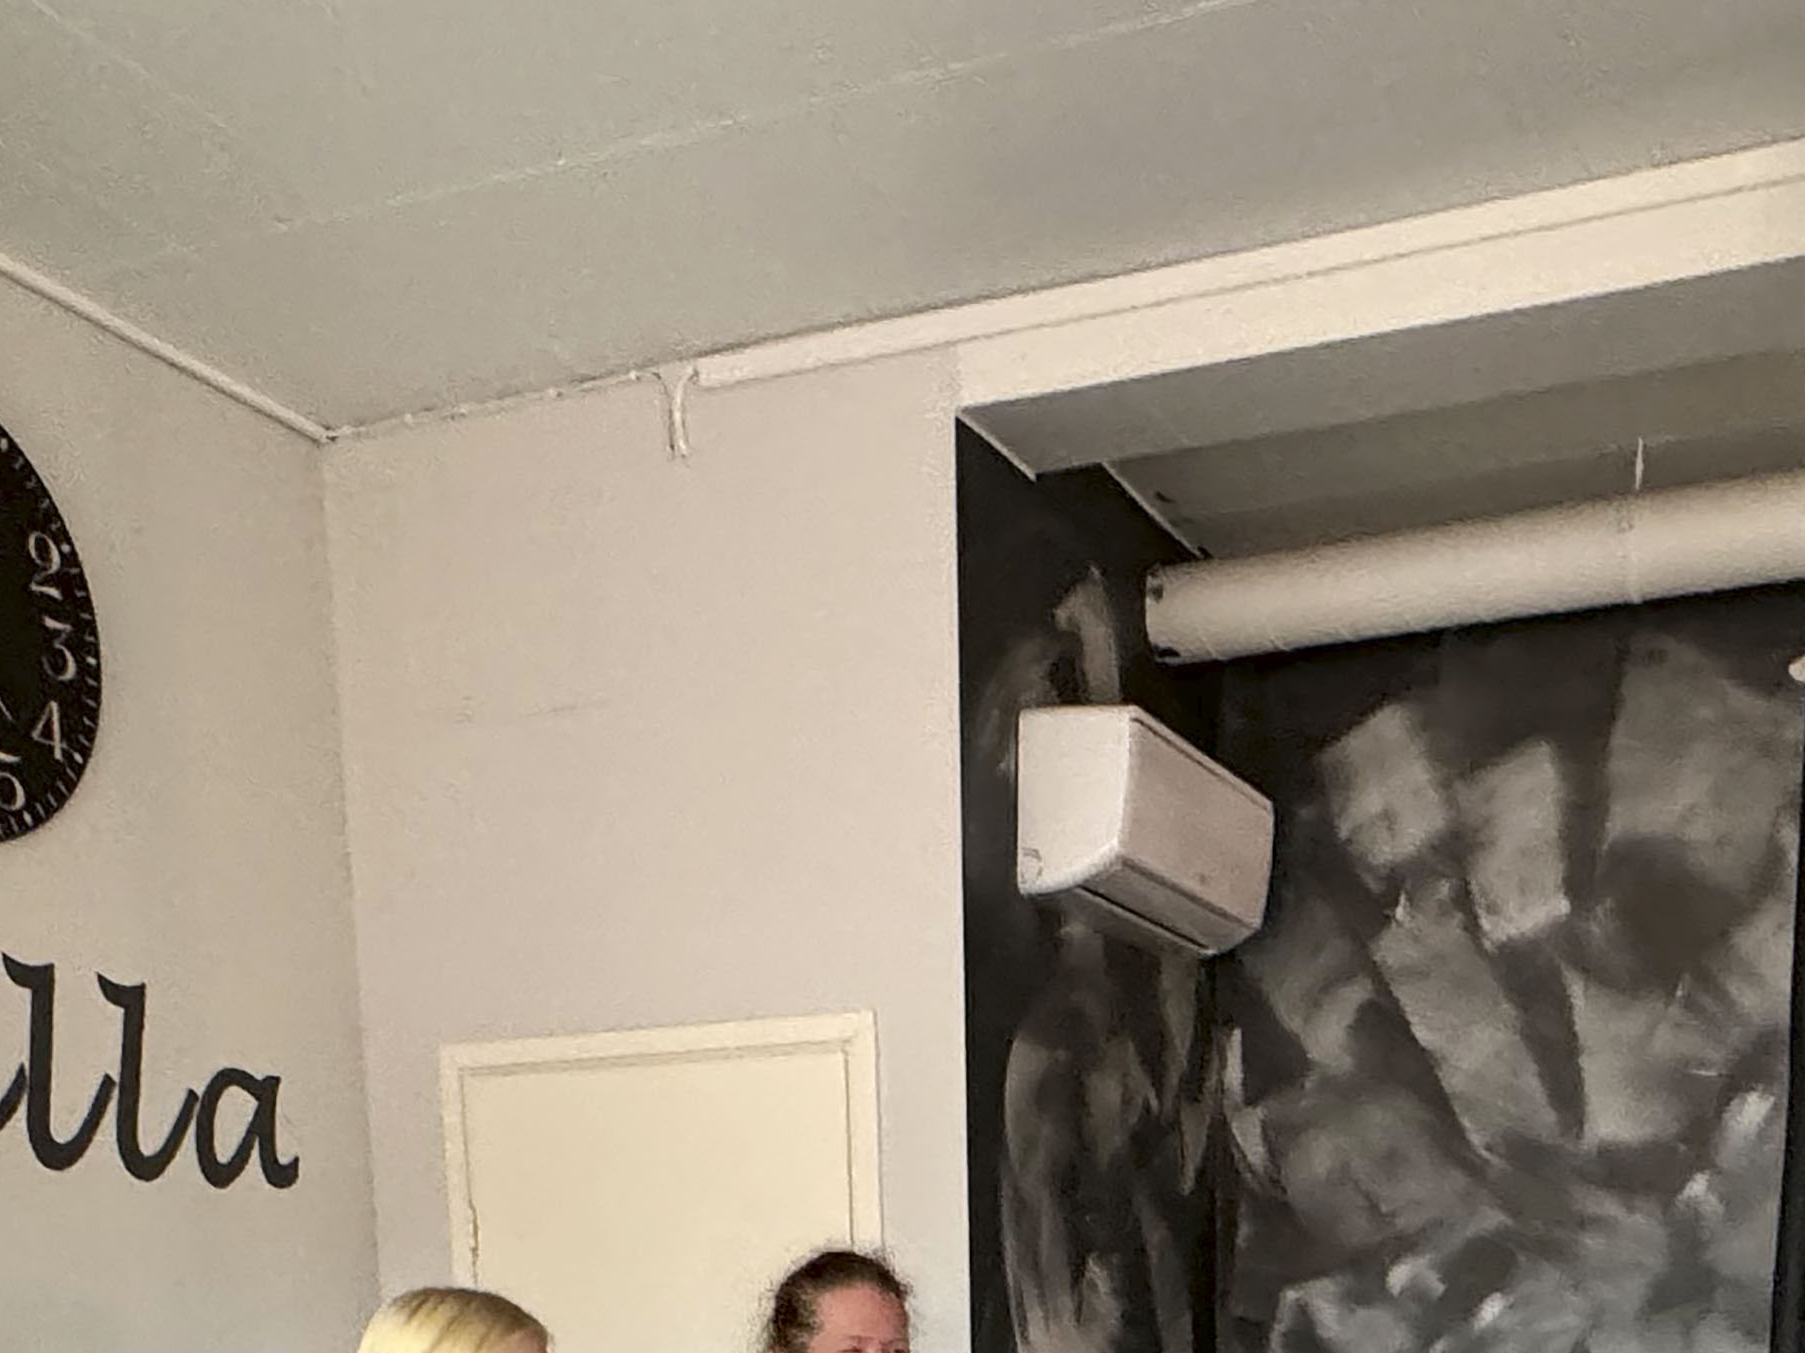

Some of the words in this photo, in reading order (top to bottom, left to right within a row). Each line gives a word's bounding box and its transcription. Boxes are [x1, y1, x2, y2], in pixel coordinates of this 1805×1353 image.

[28, 532, 62, 600] 2
[42, 617, 77, 682] 3
[33, 701, 67, 761] 4
